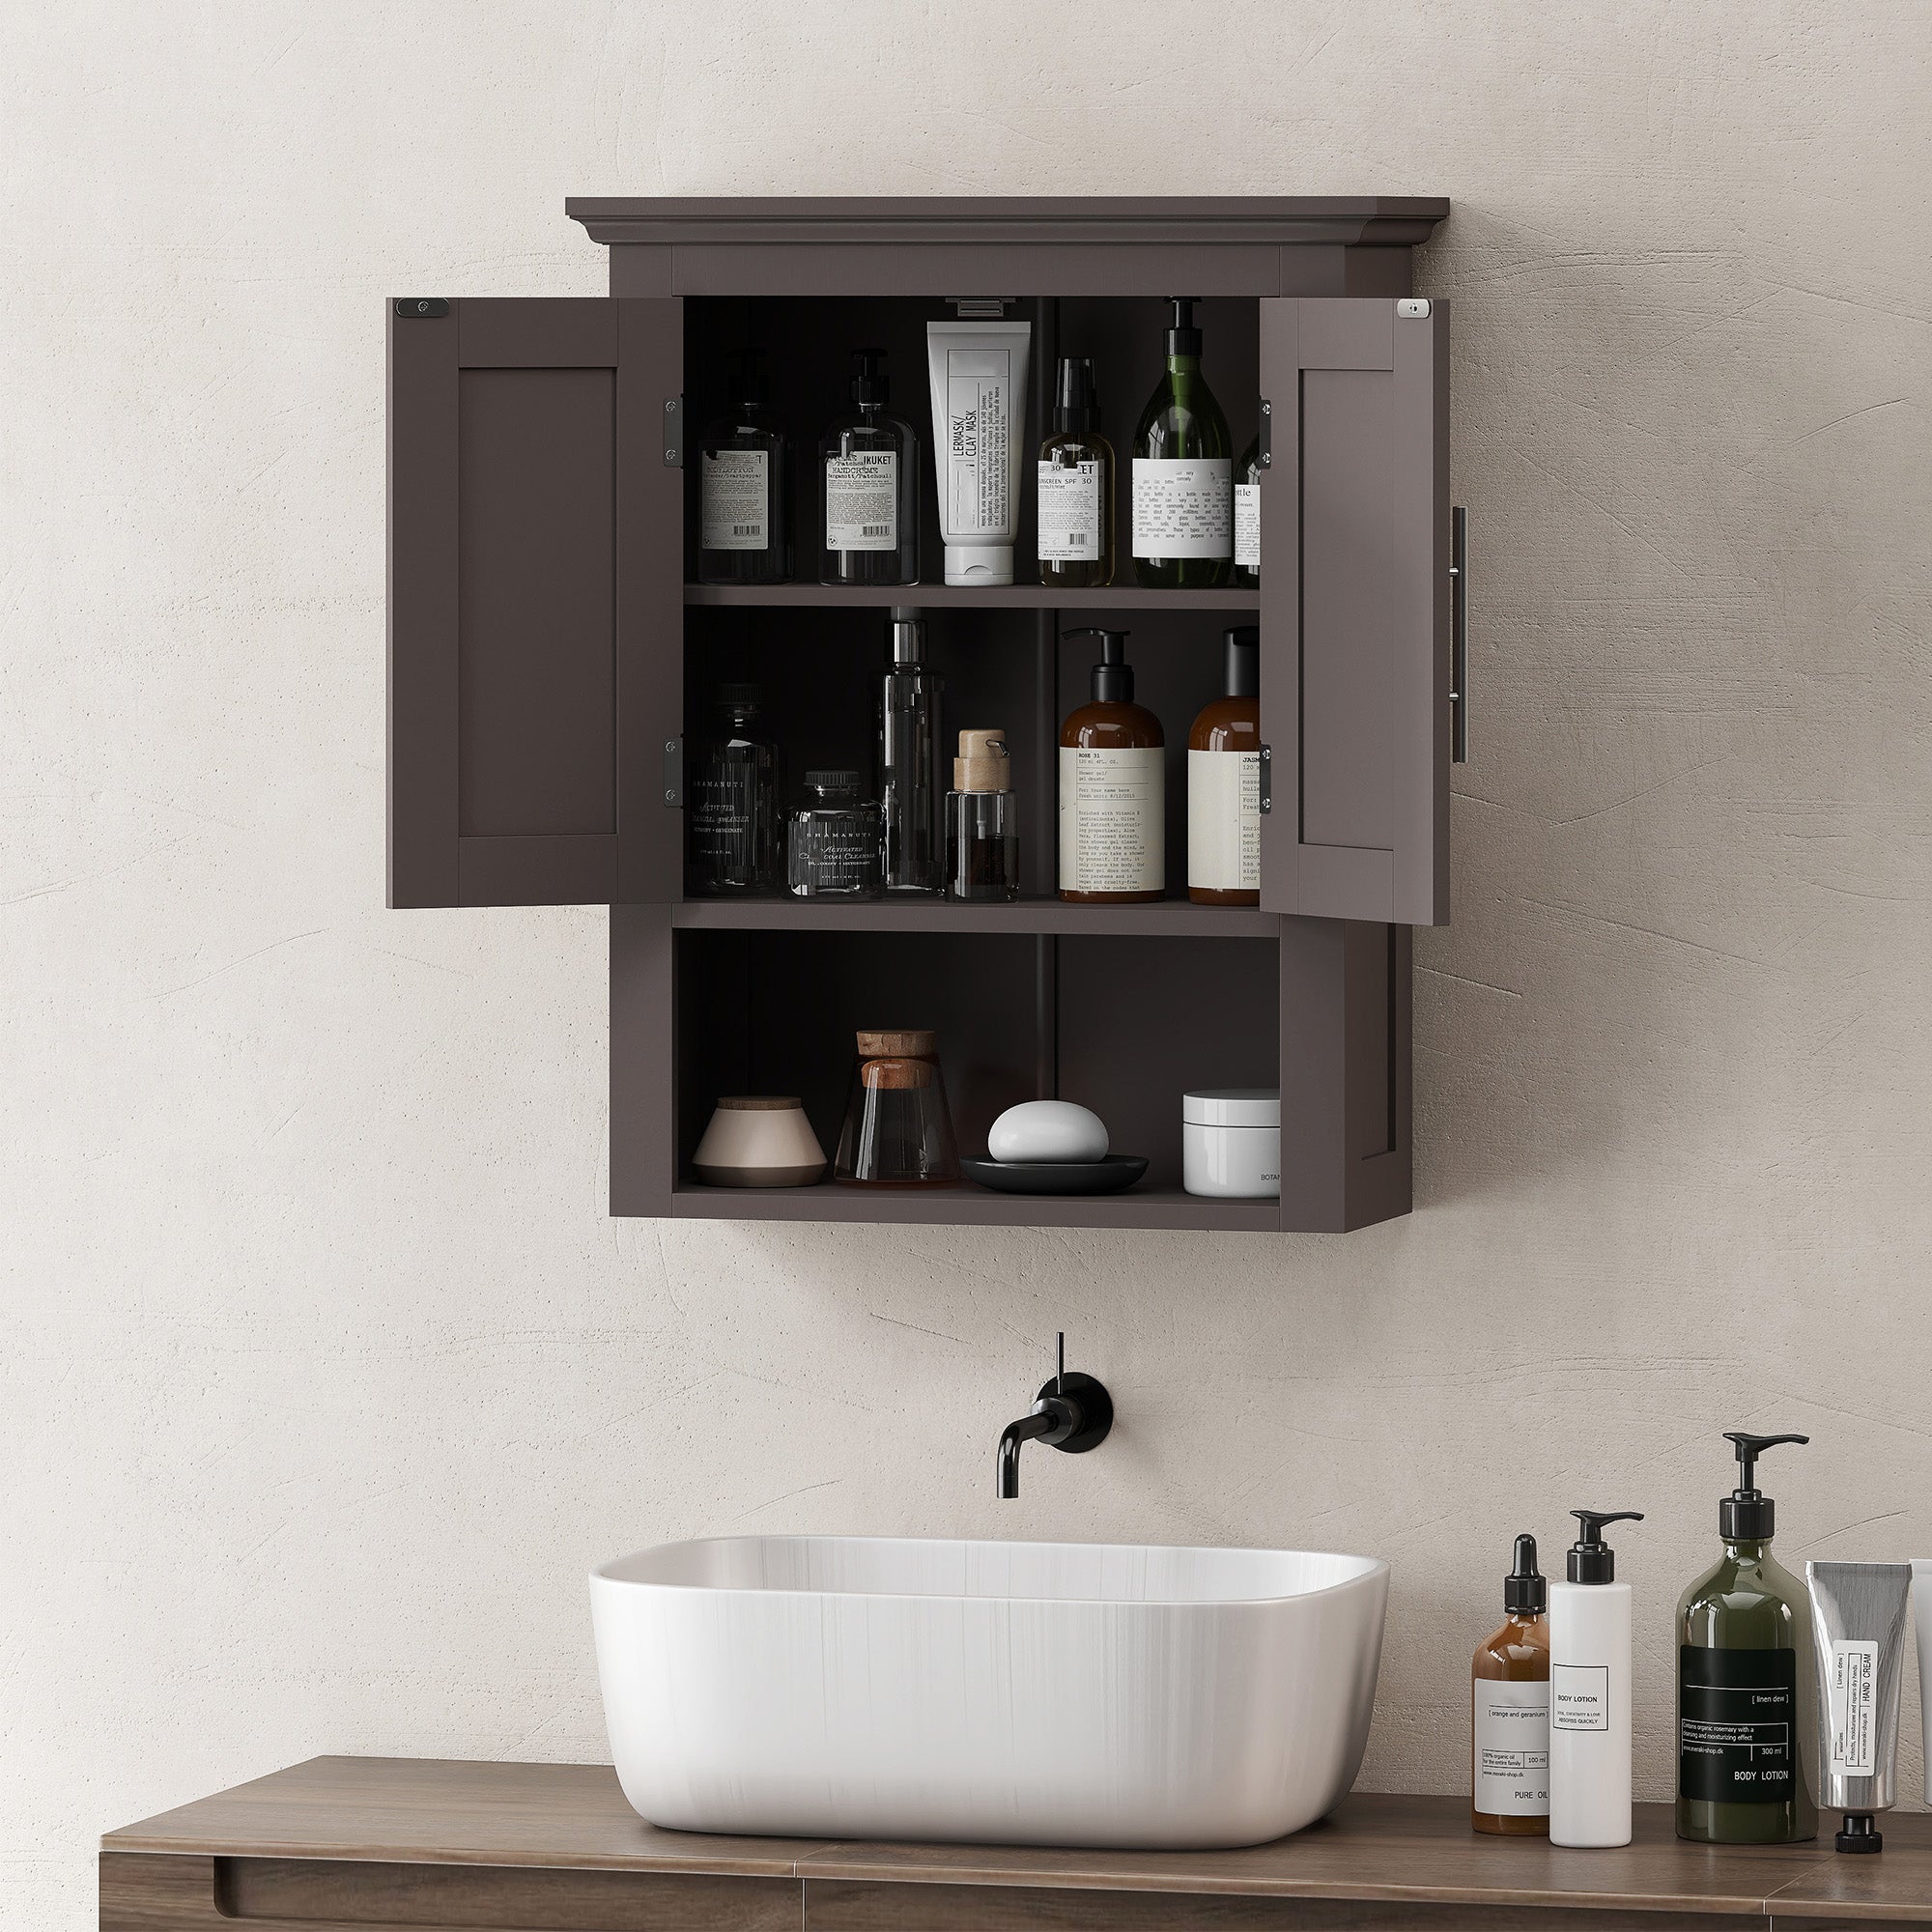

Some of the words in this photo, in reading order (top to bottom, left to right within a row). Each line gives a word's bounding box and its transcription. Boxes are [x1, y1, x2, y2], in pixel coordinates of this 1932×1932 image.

[965, 410, 977, 431] MASK
[965, 436, 977, 457] CLAY
[1862, 1653, 1871, 1678] CREAM
[1734, 1771, 1756, 1780] BODY
[1761, 1770, 1789, 1780] LOTION
[1514, 1791, 1534, 1800] PURE
